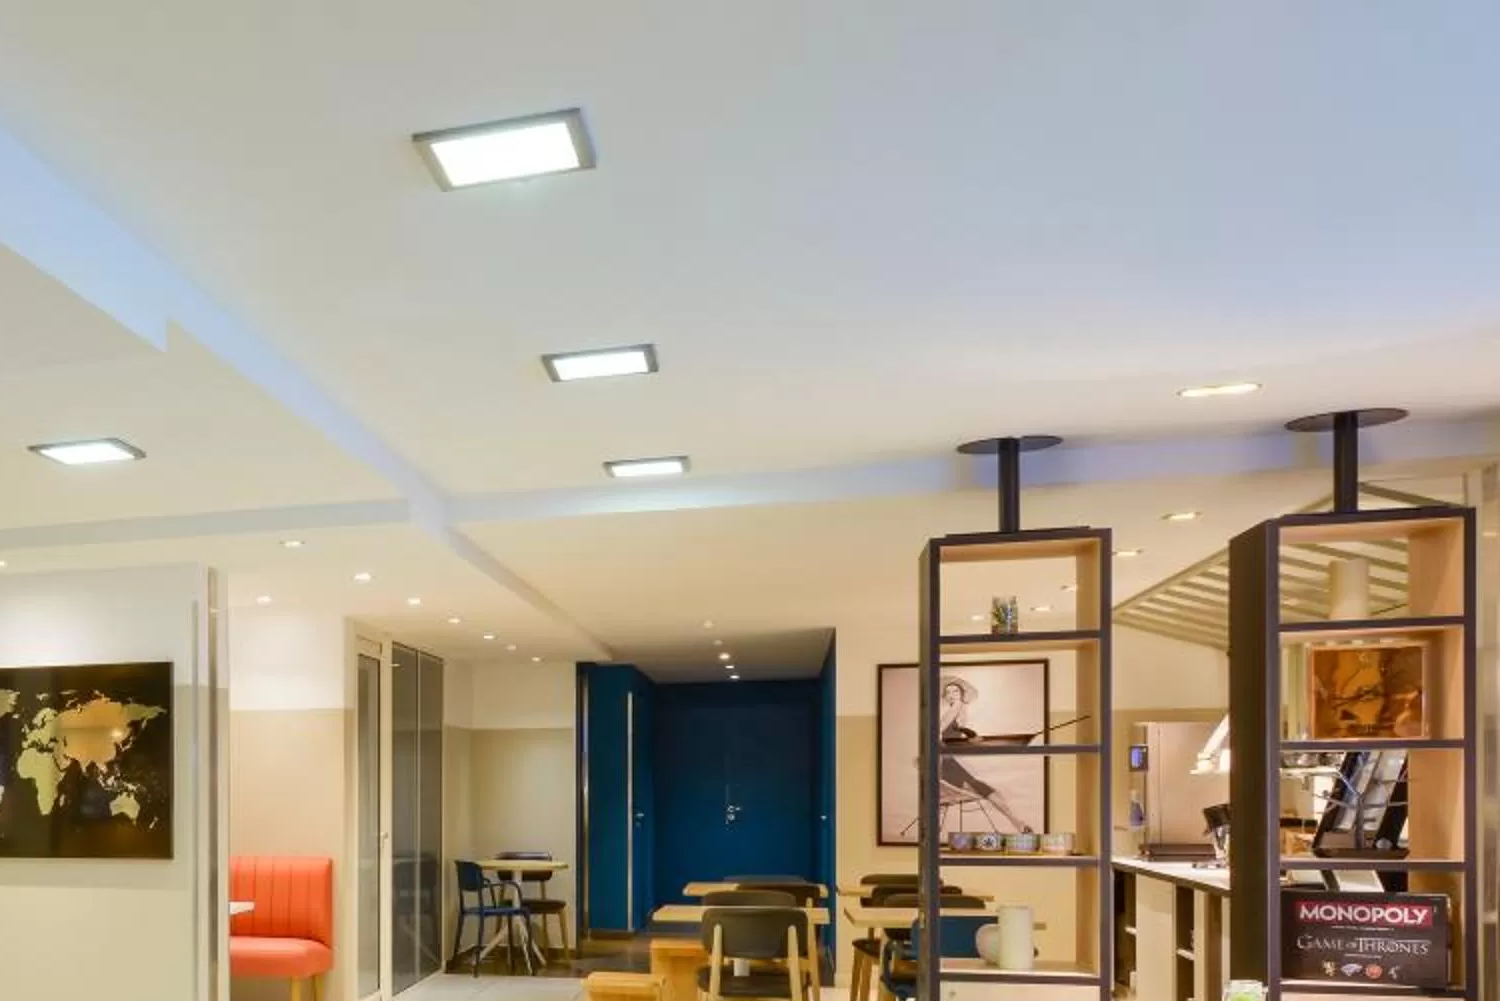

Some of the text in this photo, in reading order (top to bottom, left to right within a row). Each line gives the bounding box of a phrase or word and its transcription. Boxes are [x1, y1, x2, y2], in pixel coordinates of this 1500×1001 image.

[1300, 904, 1428, 925] MONOPOLY
[1297, 934, 1343, 950] GAME
[1357, 937, 1430, 955] THRONES
